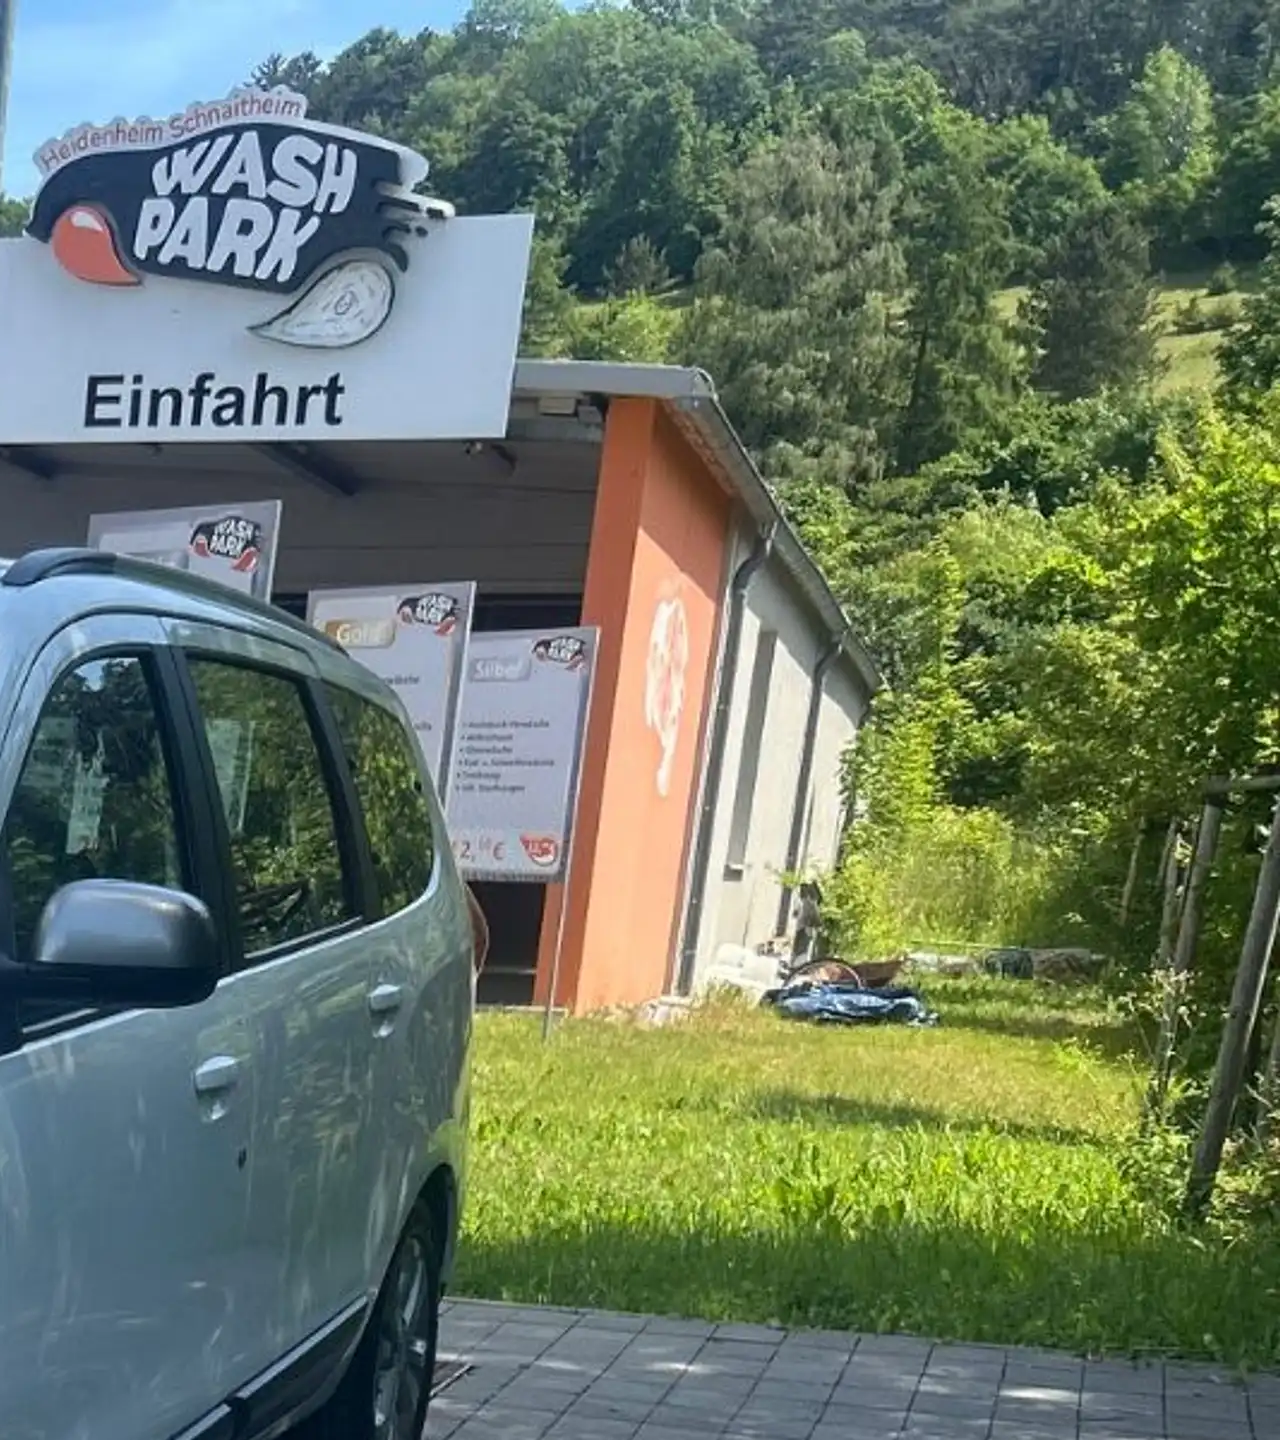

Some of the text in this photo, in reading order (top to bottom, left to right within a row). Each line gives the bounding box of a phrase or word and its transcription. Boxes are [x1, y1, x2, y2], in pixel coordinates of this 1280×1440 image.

[41, 96, 302, 169] Heidenheim Schnaitheim
[151, 130, 358, 214] WASH
[133, 198, 320, 283] PARK
[84, 372, 345, 427] Einfahrt
[210, 534, 247, 558] PARK
[214, 518, 254, 540] WASH
